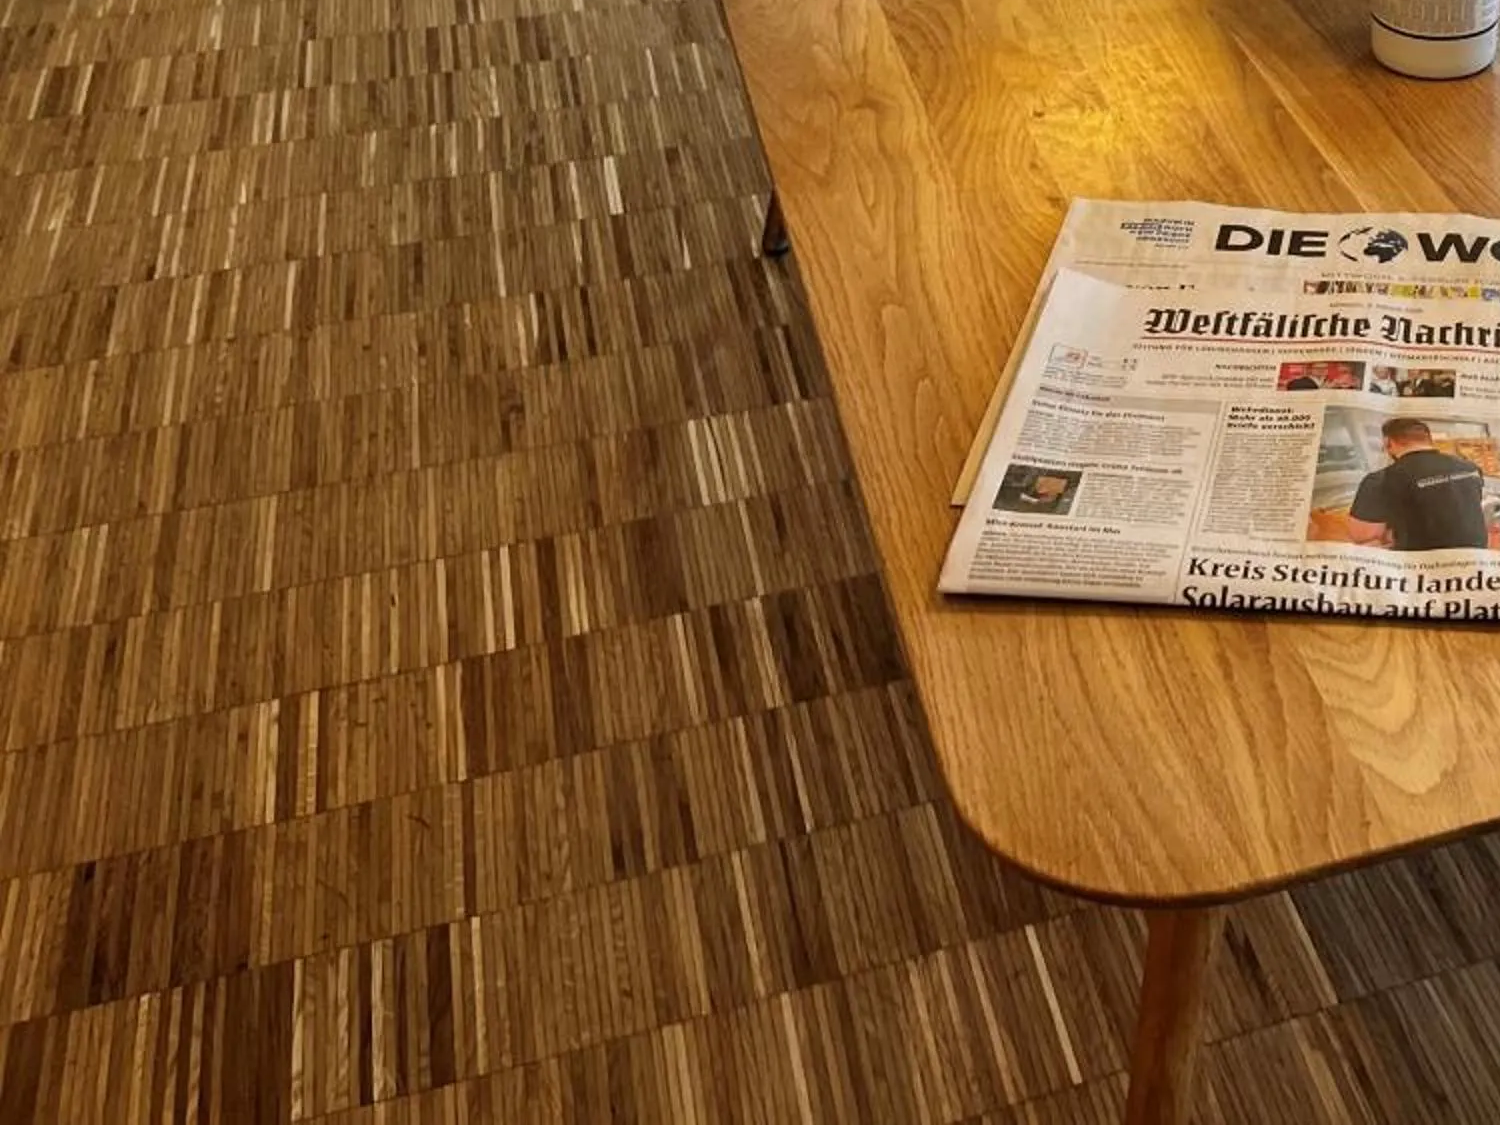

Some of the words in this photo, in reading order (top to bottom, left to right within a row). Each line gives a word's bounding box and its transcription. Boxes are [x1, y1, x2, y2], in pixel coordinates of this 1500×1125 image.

[1214, 224, 1329, 258] DIE
[1187, 557, 1267, 580] Kreis
[1271, 563, 1410, 593] Steinfurt
